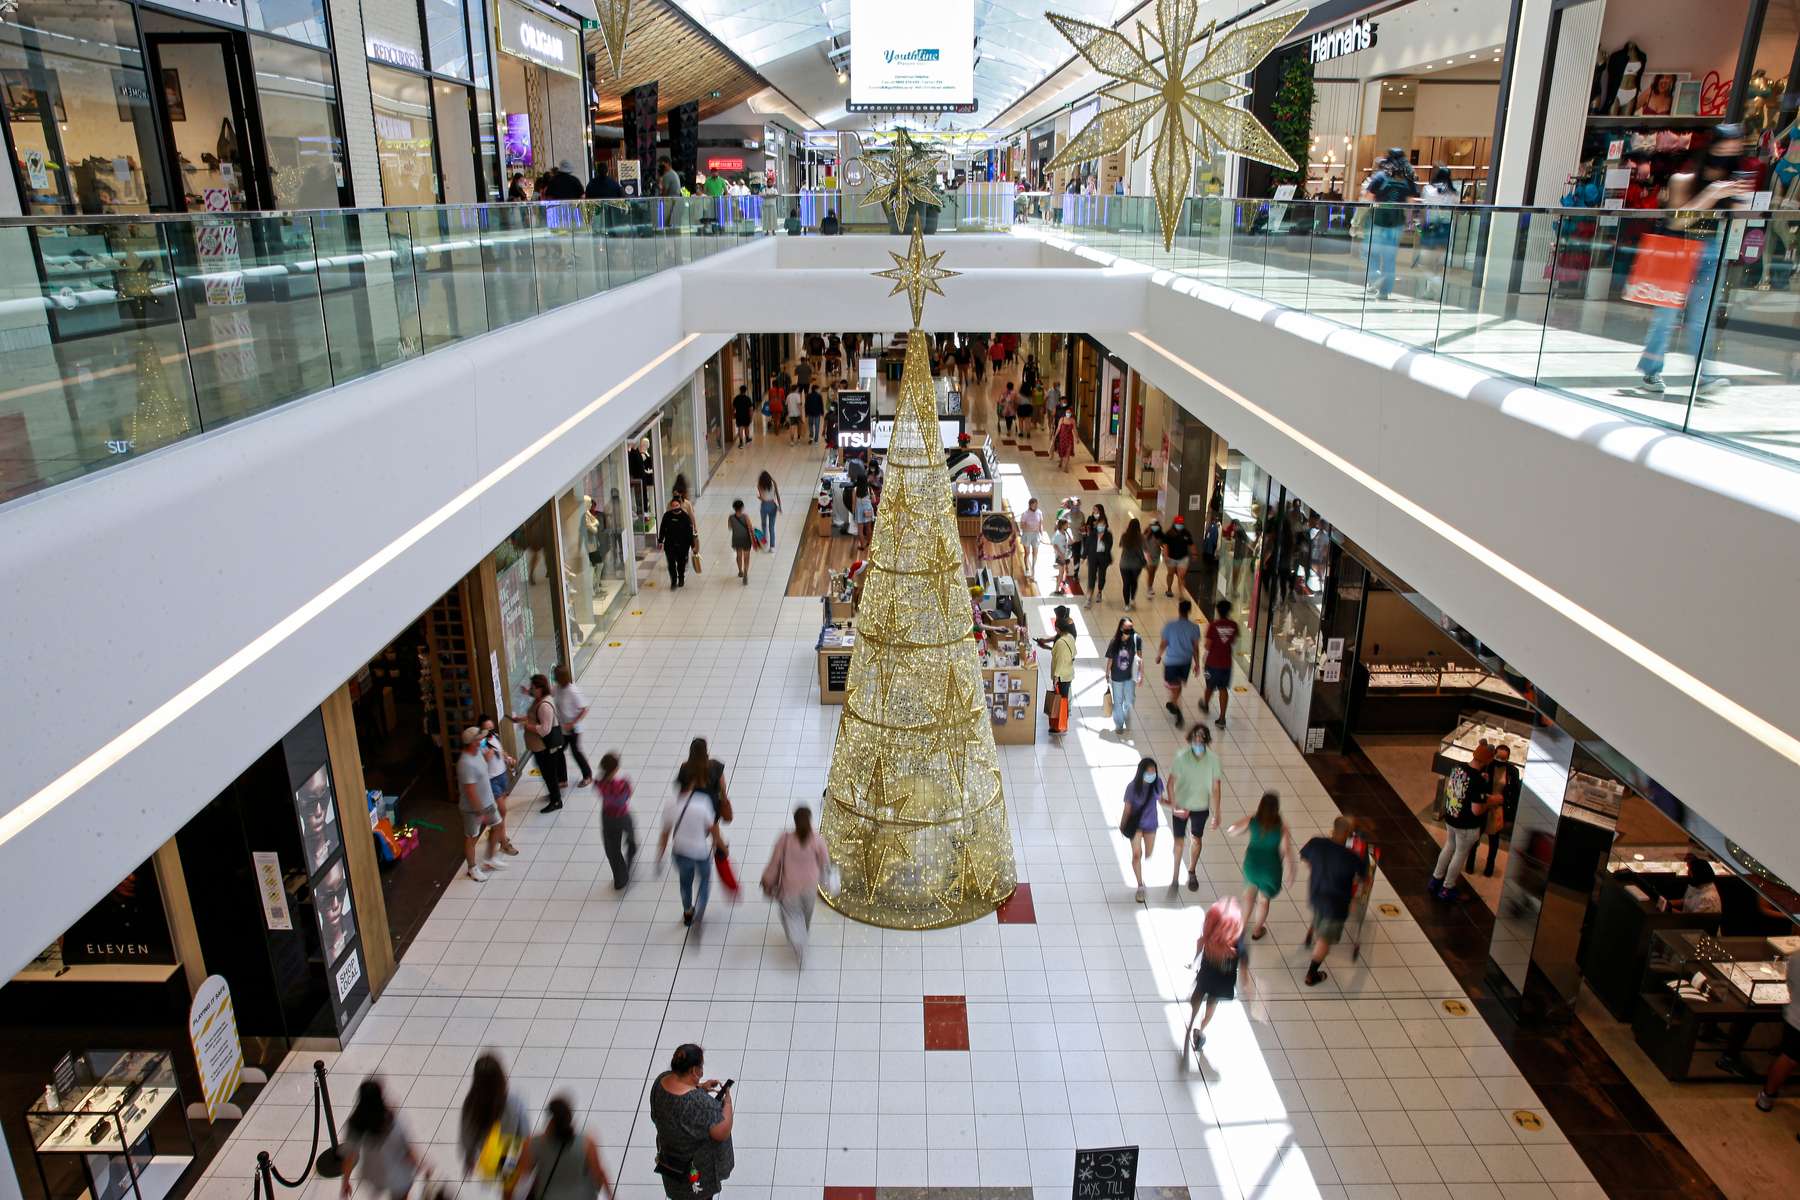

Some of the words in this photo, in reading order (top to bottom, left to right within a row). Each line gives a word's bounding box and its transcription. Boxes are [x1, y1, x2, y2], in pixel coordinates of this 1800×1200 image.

[1310, 18, 1371, 64] Hannahs
[883, 49, 940, 63] Youthline
[838, 432, 871, 448] ITSU
[86, 944, 149, 954] ELEVEN
[340, 959, 355, 984] SHOP
[341, 968, 359, 994] LOCAL
[193, 1002, 211, 1026] PLAYING
[215, 985, 226, 1000] SAFE
[1095, 1153, 1117, 1179] 3
[1079, 1182, 1100, 1200] DAYS
[1106, 1180, 1125, 1195] TILL
